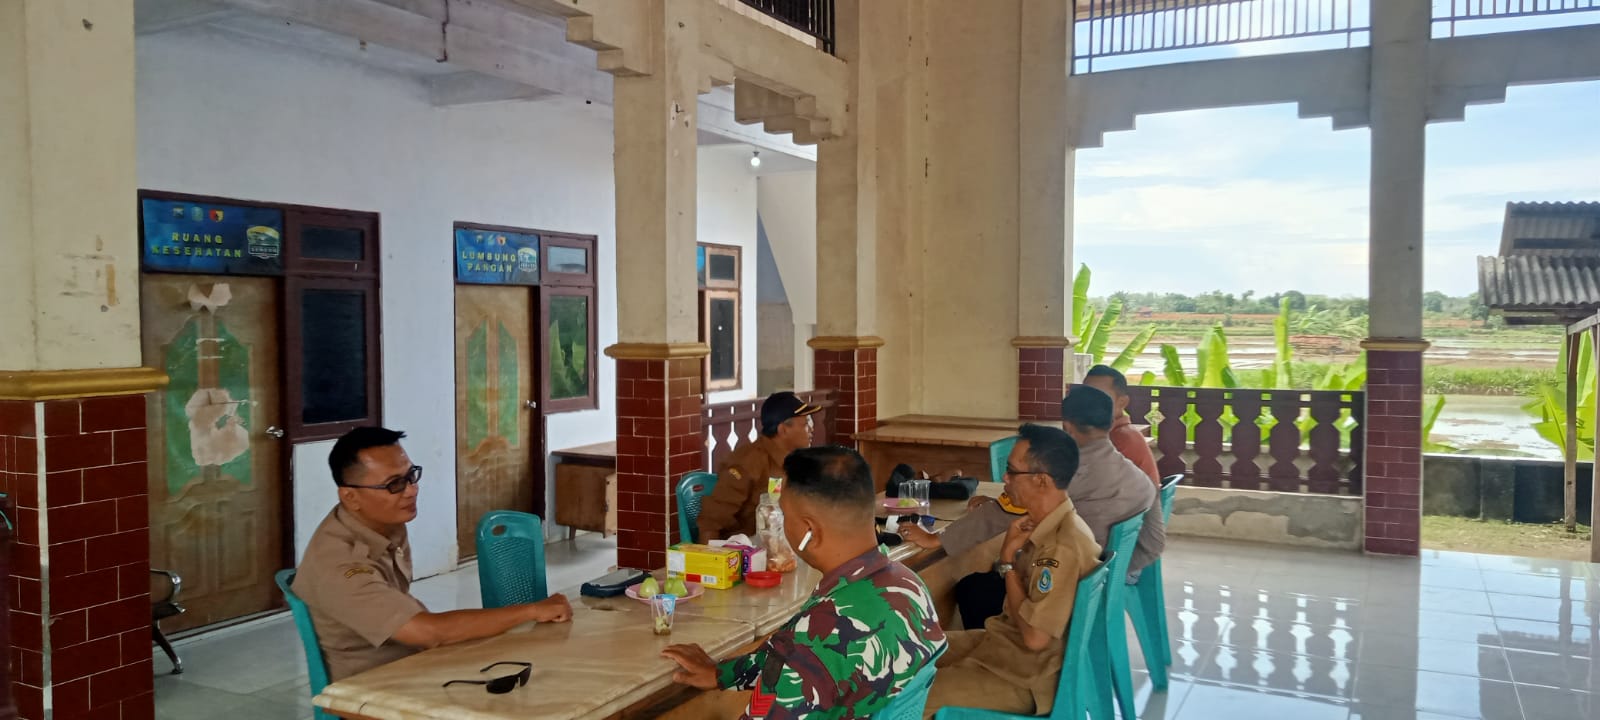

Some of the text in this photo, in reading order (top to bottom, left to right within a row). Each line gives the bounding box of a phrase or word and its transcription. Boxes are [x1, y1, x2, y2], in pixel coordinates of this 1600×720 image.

[171, 232, 223, 244] RUANG
[151, 245, 241, 258] KESEHATAN
[462, 250, 516, 262] LUMBUNG
[466, 262, 512, 273] PANGAN
